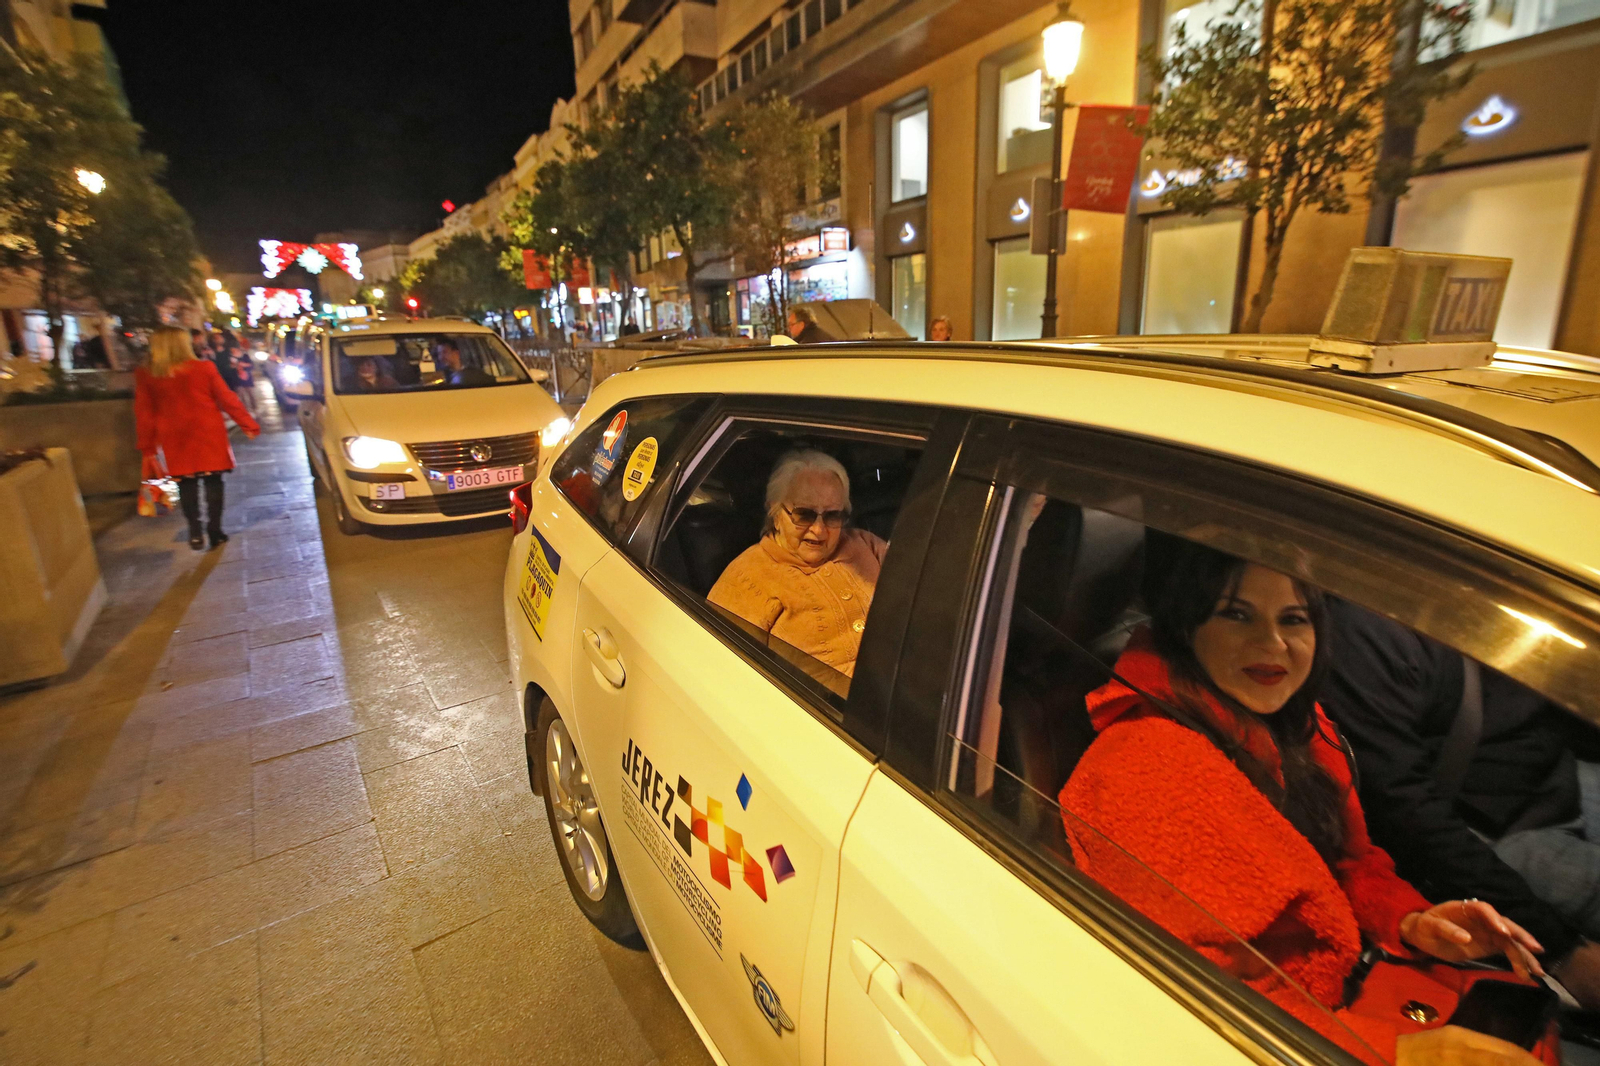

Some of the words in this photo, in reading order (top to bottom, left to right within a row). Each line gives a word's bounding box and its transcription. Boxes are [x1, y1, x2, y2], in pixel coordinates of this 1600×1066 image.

[1440, 282, 1499, 332] TAXI
[376, 484, 398, 498] SP
[456, 473, 490, 488] 9003
[497, 467, 519, 482] GTF
[622, 738, 675, 830] JEREZ
[621, 785, 638, 813] CAPITAL
[639, 808, 661, 844] MUNDIAL
[673, 855, 721, 926] MOTOCICLISMO
[622, 794, 639, 822] WORLD
[640, 821, 660, 853] CAPITAL
[671, 863, 722, 939] MOTORCYCLING
[676, 880, 722, 950] MOTOCYCLISME
